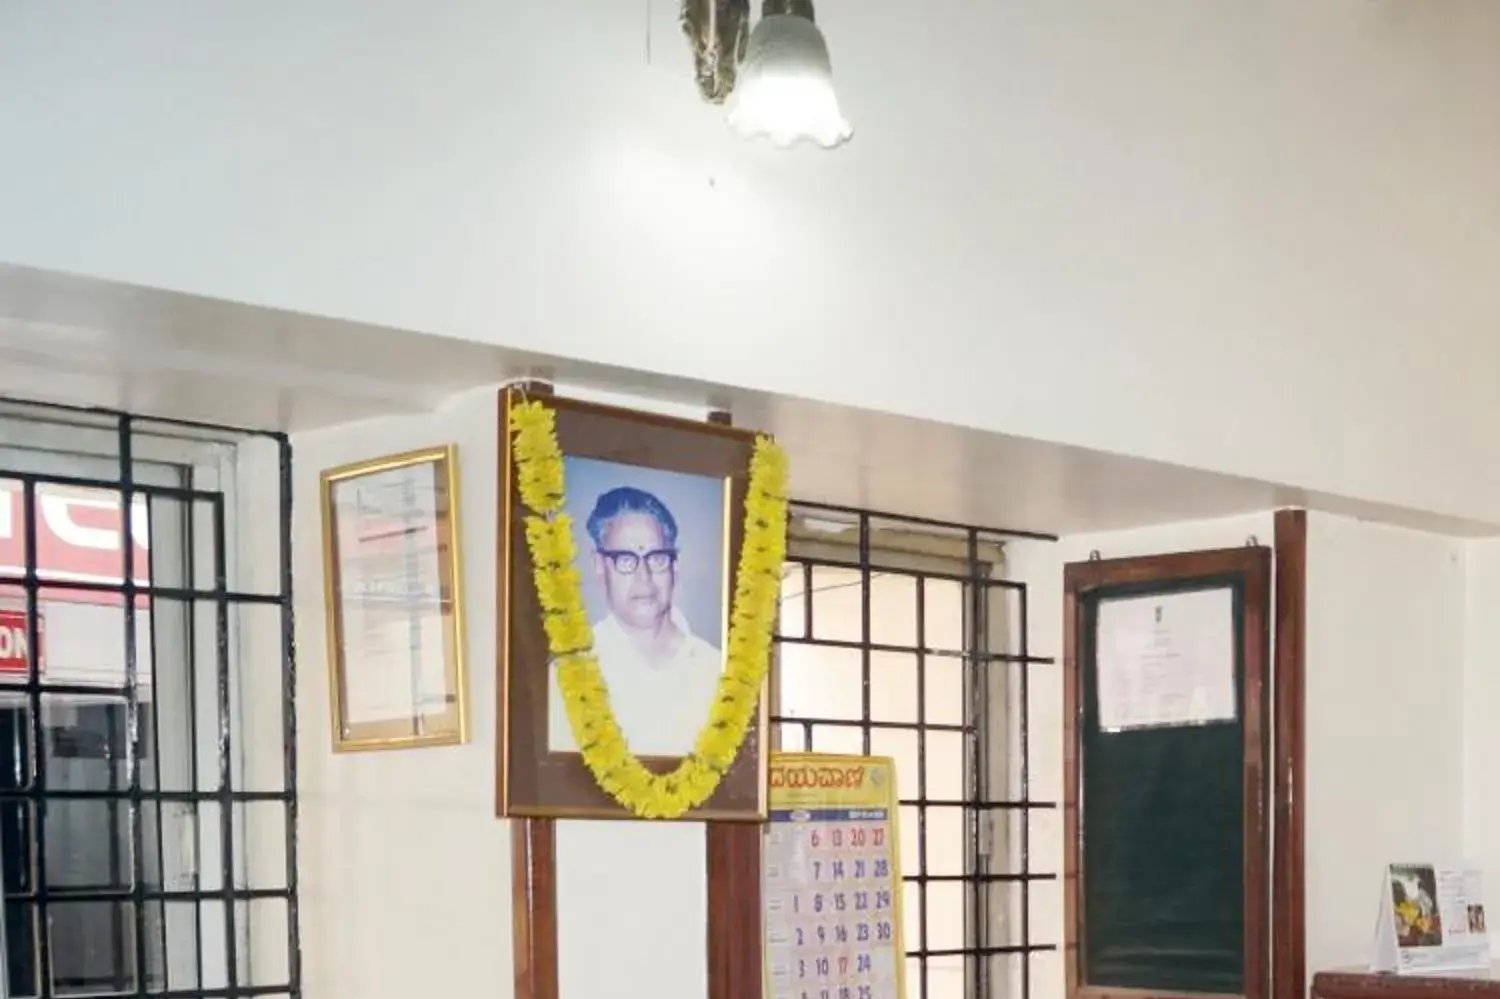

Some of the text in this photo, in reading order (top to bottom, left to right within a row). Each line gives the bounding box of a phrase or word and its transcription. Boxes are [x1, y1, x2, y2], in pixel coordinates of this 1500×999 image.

[811, 829, 819, 847] 6
[851, 828, 865, 847] 20
[873, 828, 884, 846] 27
[814, 859, 888, 880] 7 14 21 28
[793, 895, 799, 912] 1
[835, 893, 846, 911] 15
[876, 891, 890, 909] 29
[796, 927, 803, 946] 2
[857, 923, 869, 941] 23
[877, 921, 890, 939] 30
[816, 957, 827, 976] 10
[838, 956, 848, 974] 17
[857, 954, 870, 973] 24
